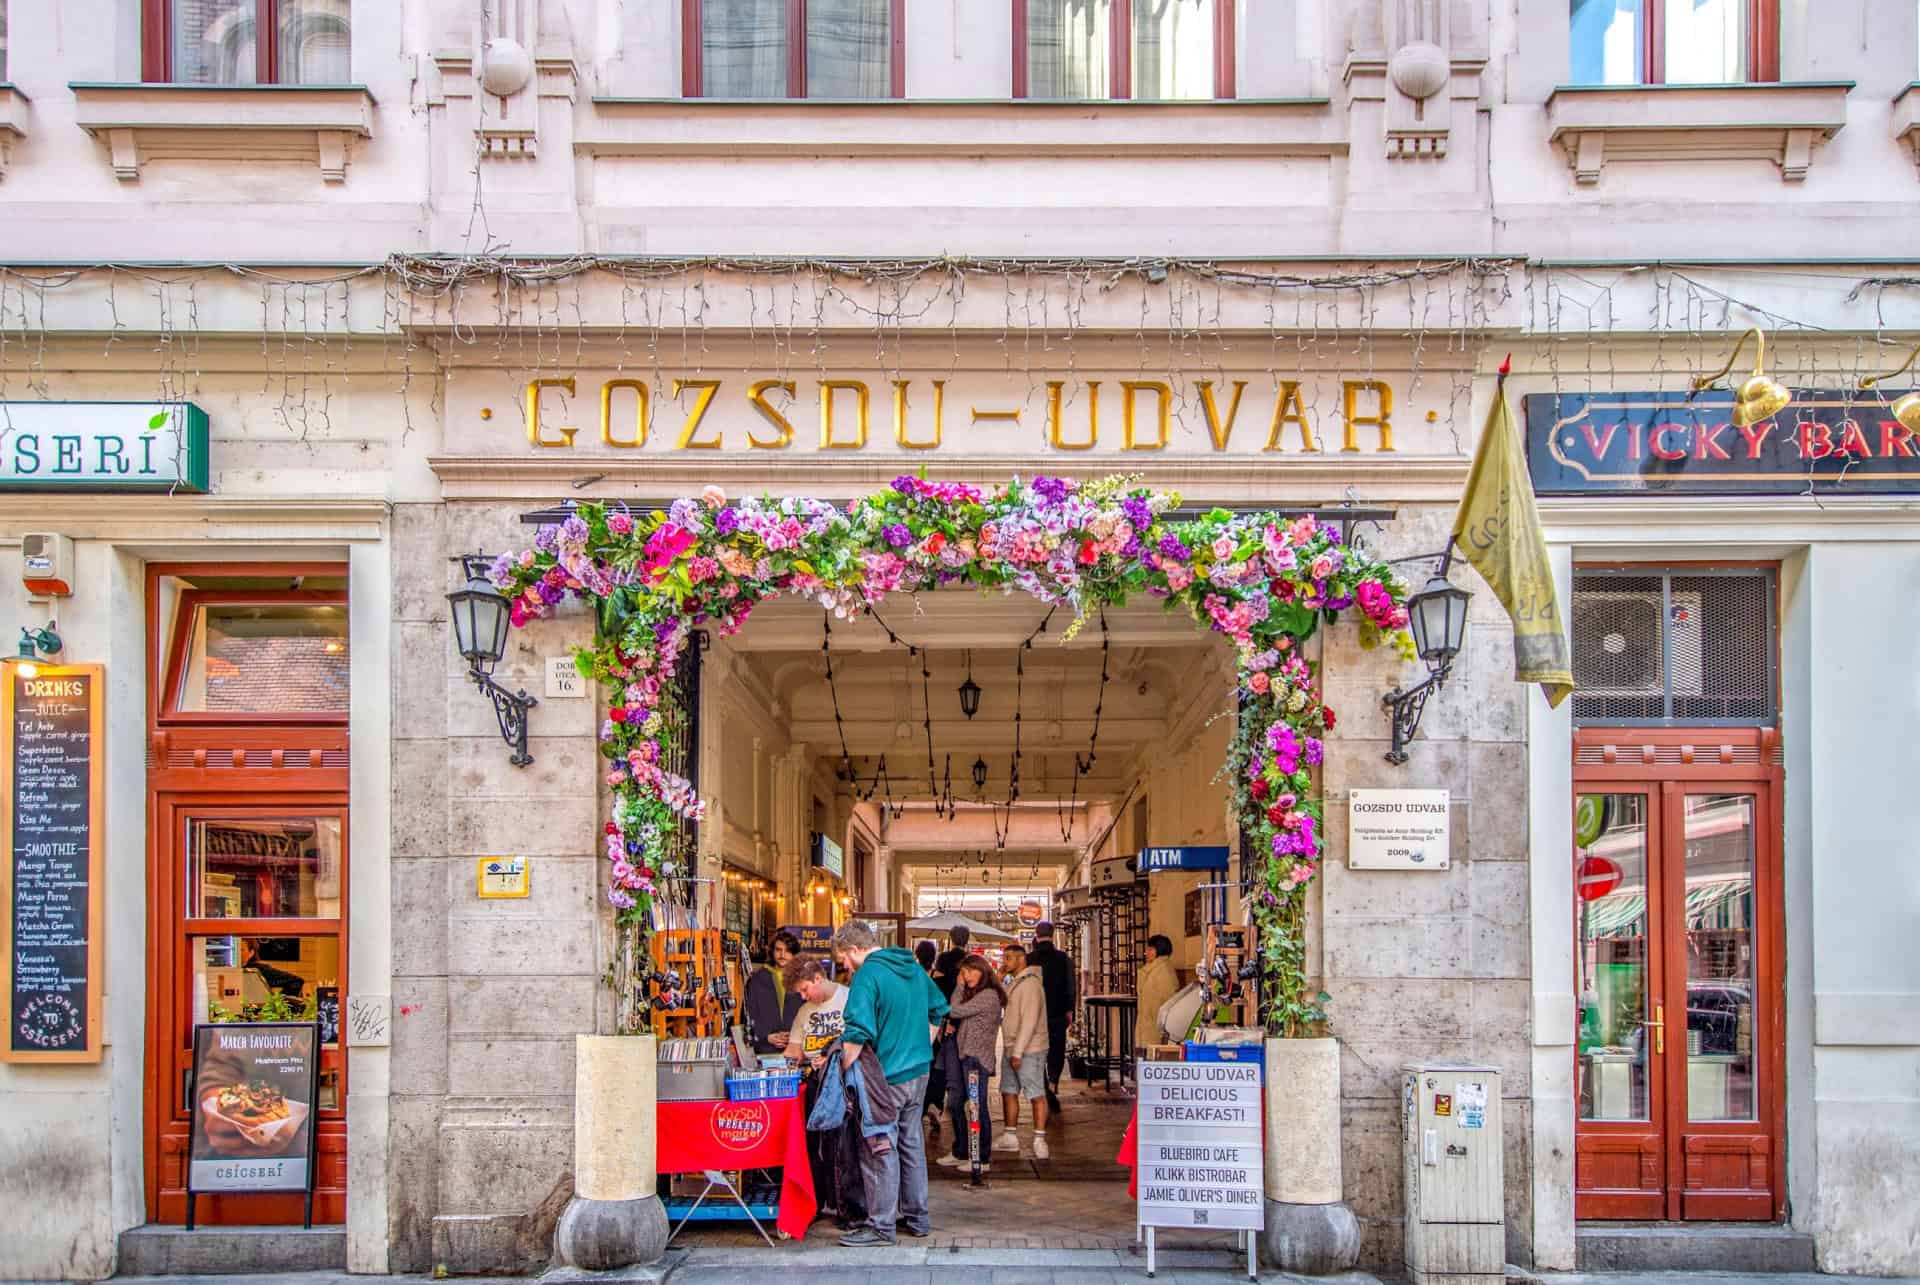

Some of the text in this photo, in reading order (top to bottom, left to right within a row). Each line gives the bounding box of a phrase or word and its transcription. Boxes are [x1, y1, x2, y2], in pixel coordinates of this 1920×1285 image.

[0, 413, 166, 475] SERÍ
[1580, 422, 1914, 460] VICKY BAR
[24, 680, 84, 697] DRINKS
[35, 703, 69, 716] JUICE
[19, 791, 49, 803] Refresh
[1353, 803, 1446, 813] GOZSDU UDVAR
[25, 842, 78, 857] SMOOTHIE
[1150, 848, 1182, 866] ATM
[1387, 848, 1410, 856] 2009
[802, 930, 818, 939] NO
[21, 994, 79, 1019] WELCOME
[43, 1012, 58, 1025] TO
[809, 1008, 840, 1022] Save
[1143, 1067, 1256, 1082] GOZSDU UDVAR
[1161, 1087, 1239, 1102] DELICIOUS
[1154, 1107, 1245, 1122] BREAKFAST!
[1160, 1146, 1240, 1162] BLUEBIRD CAFE
[1154, 1167, 1247, 1183] KLIKK BISTROBAR
[1144, 1187, 1259, 1205] JAMIE OLIVER'S DINER
